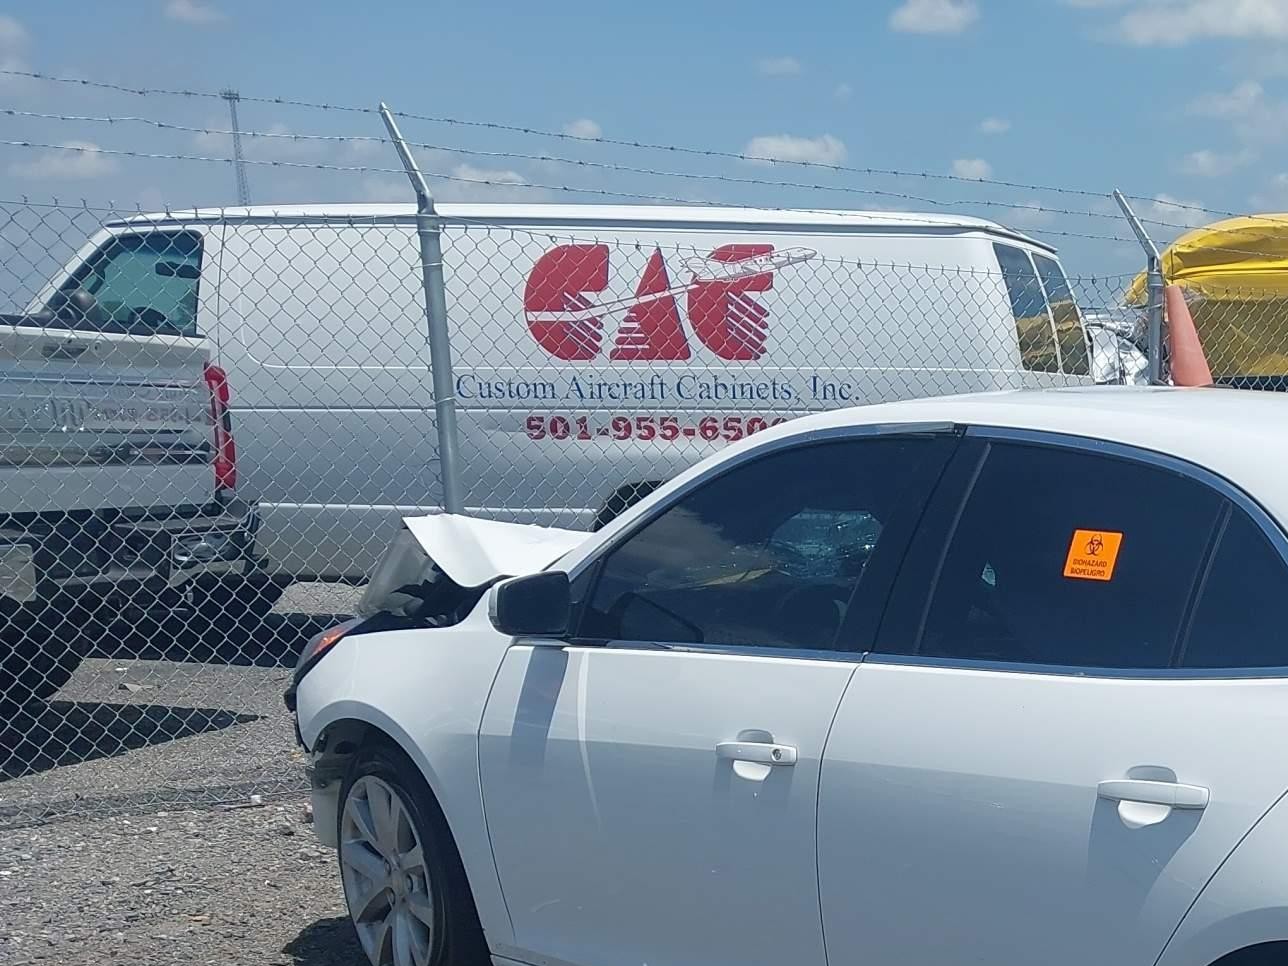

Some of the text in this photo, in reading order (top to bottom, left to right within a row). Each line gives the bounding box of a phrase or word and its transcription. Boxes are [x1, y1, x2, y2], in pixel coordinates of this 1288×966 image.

[524, 244, 774, 360] CAC
[456, 374, 860, 402] Custom Aircraft Cabinets, Inc.
[526, 416, 788, 441] 501-955-650
[1073, 559, 1107, 568] BIOHAZARD
